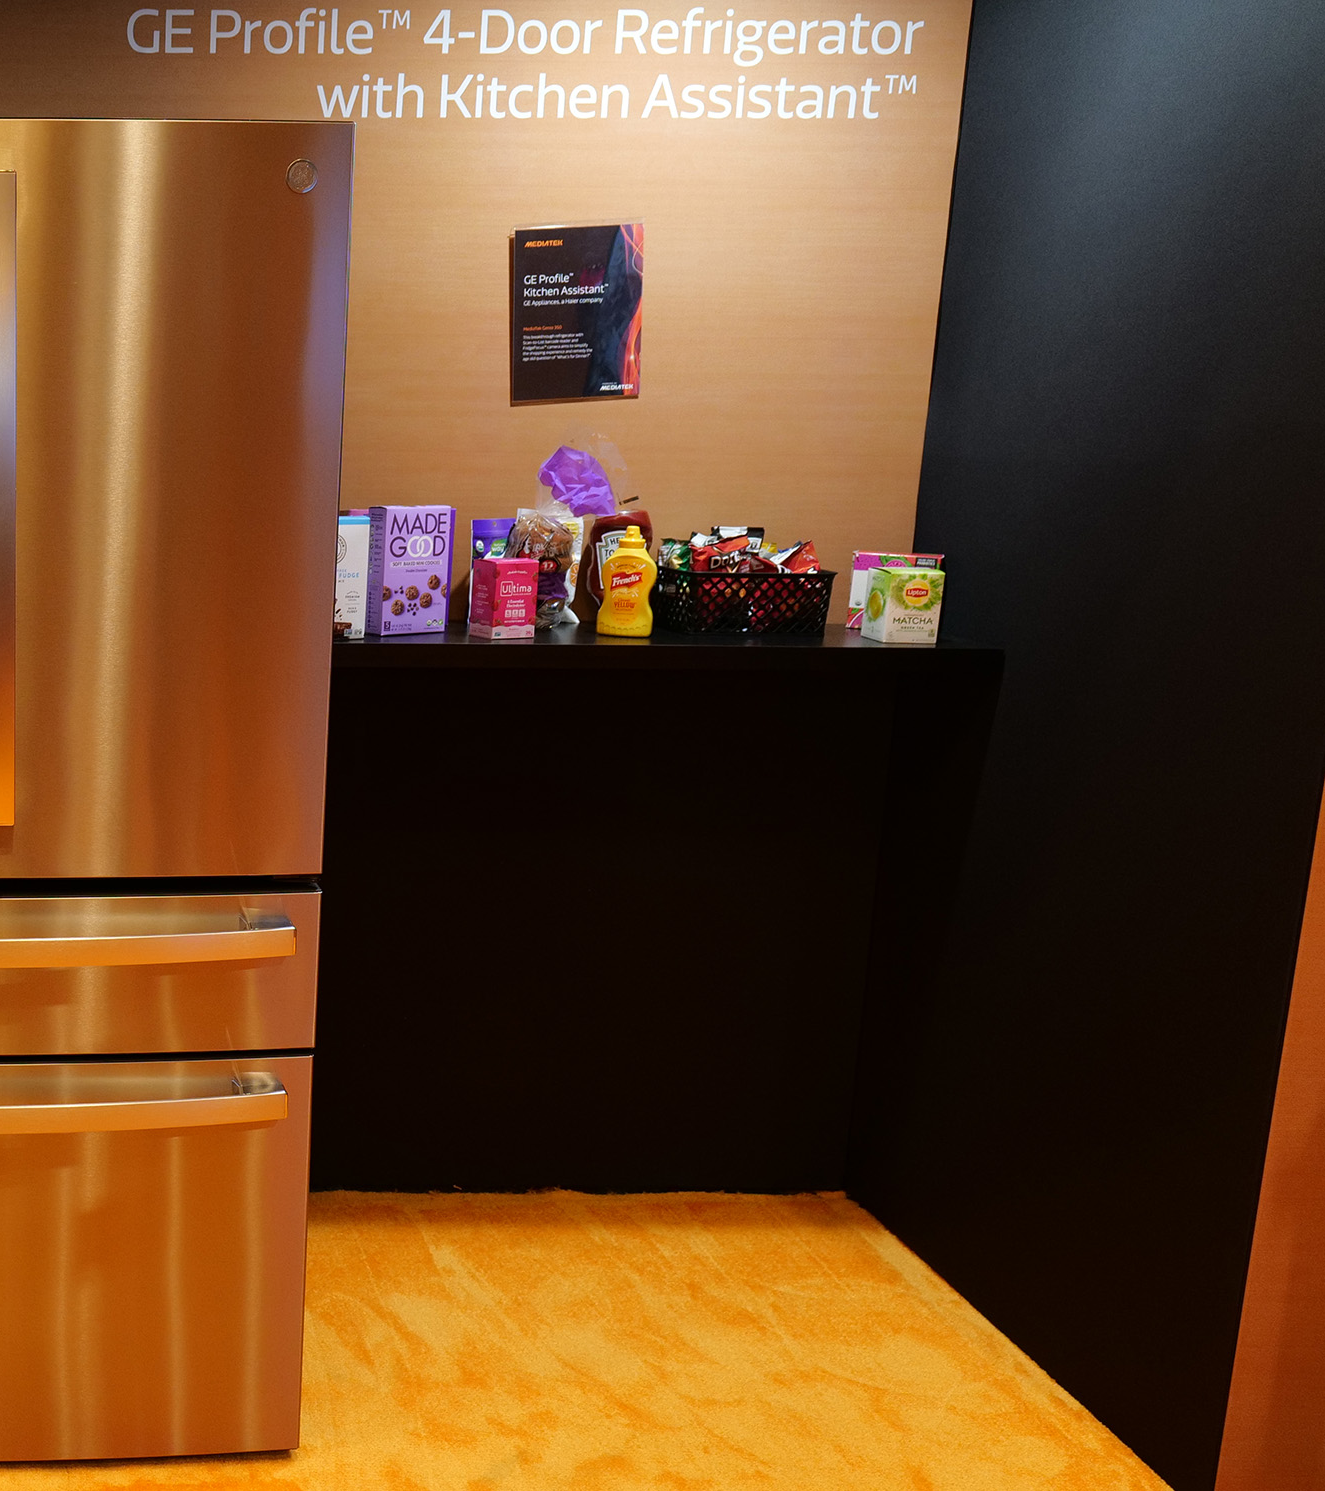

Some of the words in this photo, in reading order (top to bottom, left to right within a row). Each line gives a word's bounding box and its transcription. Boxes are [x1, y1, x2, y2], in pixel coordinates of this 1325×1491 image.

[126, 9, 194, 54] GE
[423, 9, 604, 55] 4-Door
[615, 7, 925, 67] Refrigerator
[317, 73, 424, 119] with
[439, 72, 630, 119] Kitchen
[524, 274, 537, 284] GE
[524, 287, 559, 297] Kitchen
[390, 513, 447, 535] MADE
[390, 535, 446, 557] GOOD
[612, 574, 641, 587] French's
